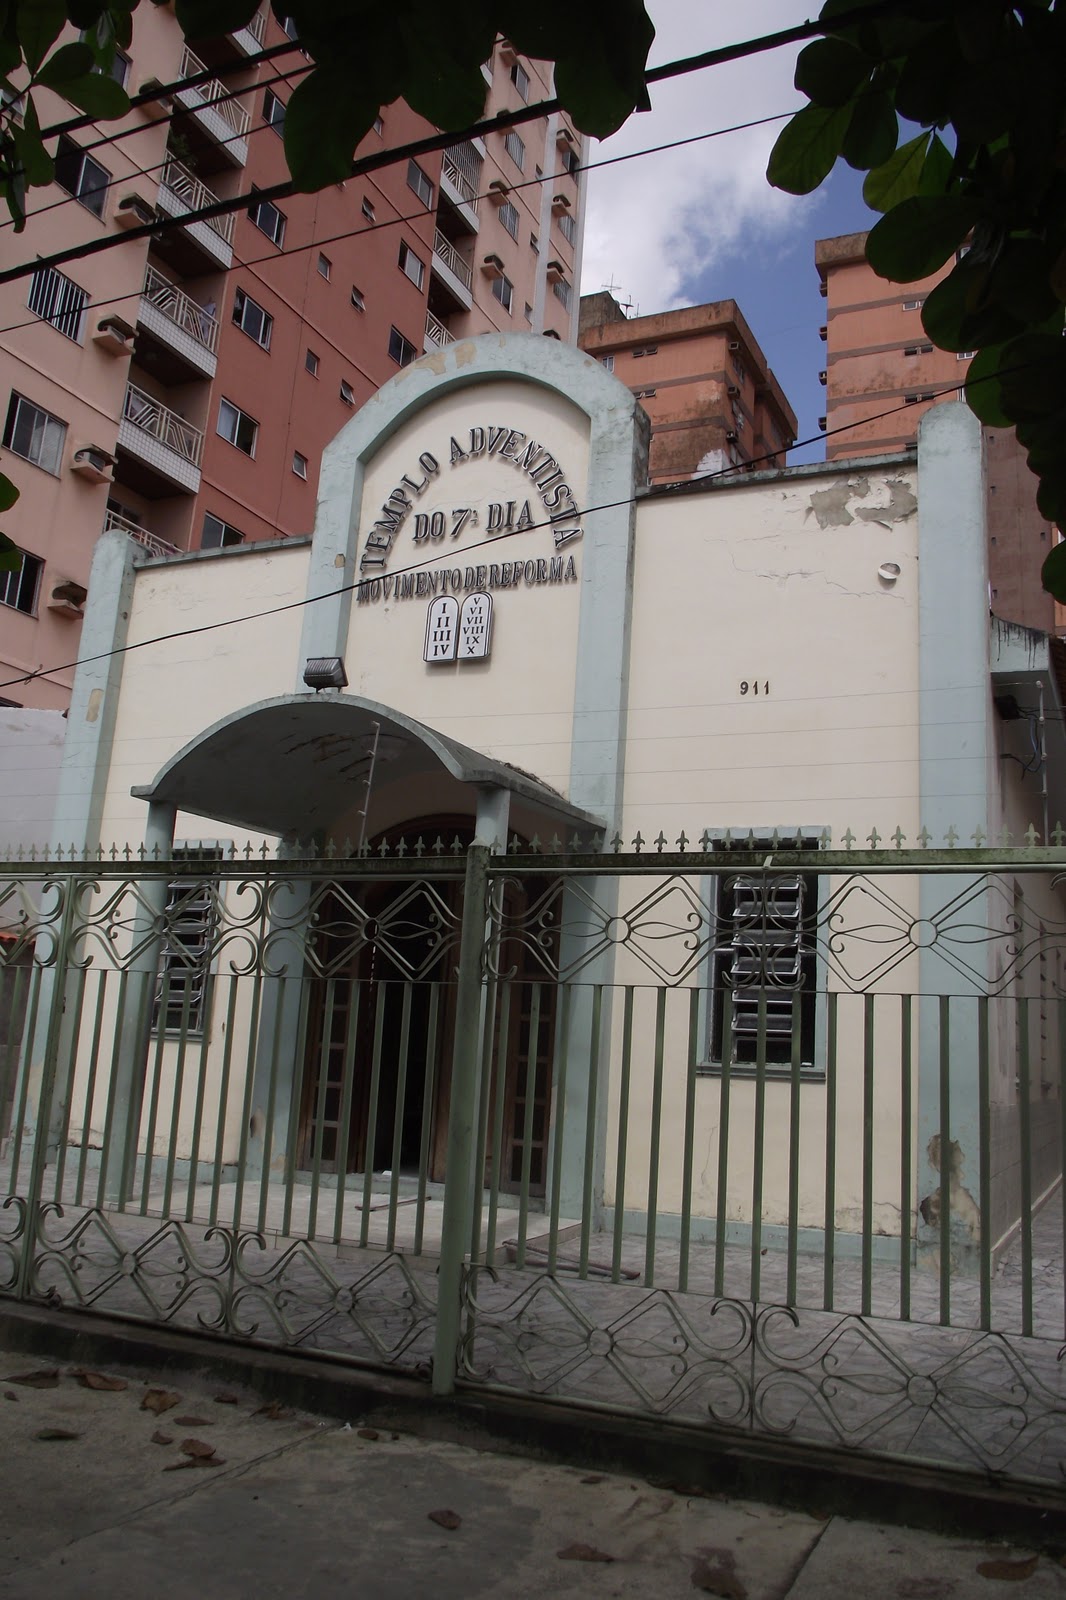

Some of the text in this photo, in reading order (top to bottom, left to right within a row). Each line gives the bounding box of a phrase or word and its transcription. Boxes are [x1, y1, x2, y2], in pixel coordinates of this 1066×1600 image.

[360, 426, 584, 574] TEMPLO ADVENTISTA
[412, 511, 445, 541] DO
[485, 499, 534, 531] DIA
[357, 556, 578, 602] MOVIMENTO DE REFORMA
[473, 597, 481, 605] V
[442, 603, 447, 614] I
[470, 606, 482, 615] VI
[437, 616, 450, 628] II
[466, 616, 483, 625] VII
[433, 630, 451, 642] III
[463, 626, 484, 635] VIII
[466, 636, 480, 645] IX
[433, 644, 449, 656] IV
[467, 646, 475, 655] X
[740, 680, 769, 696] 911
